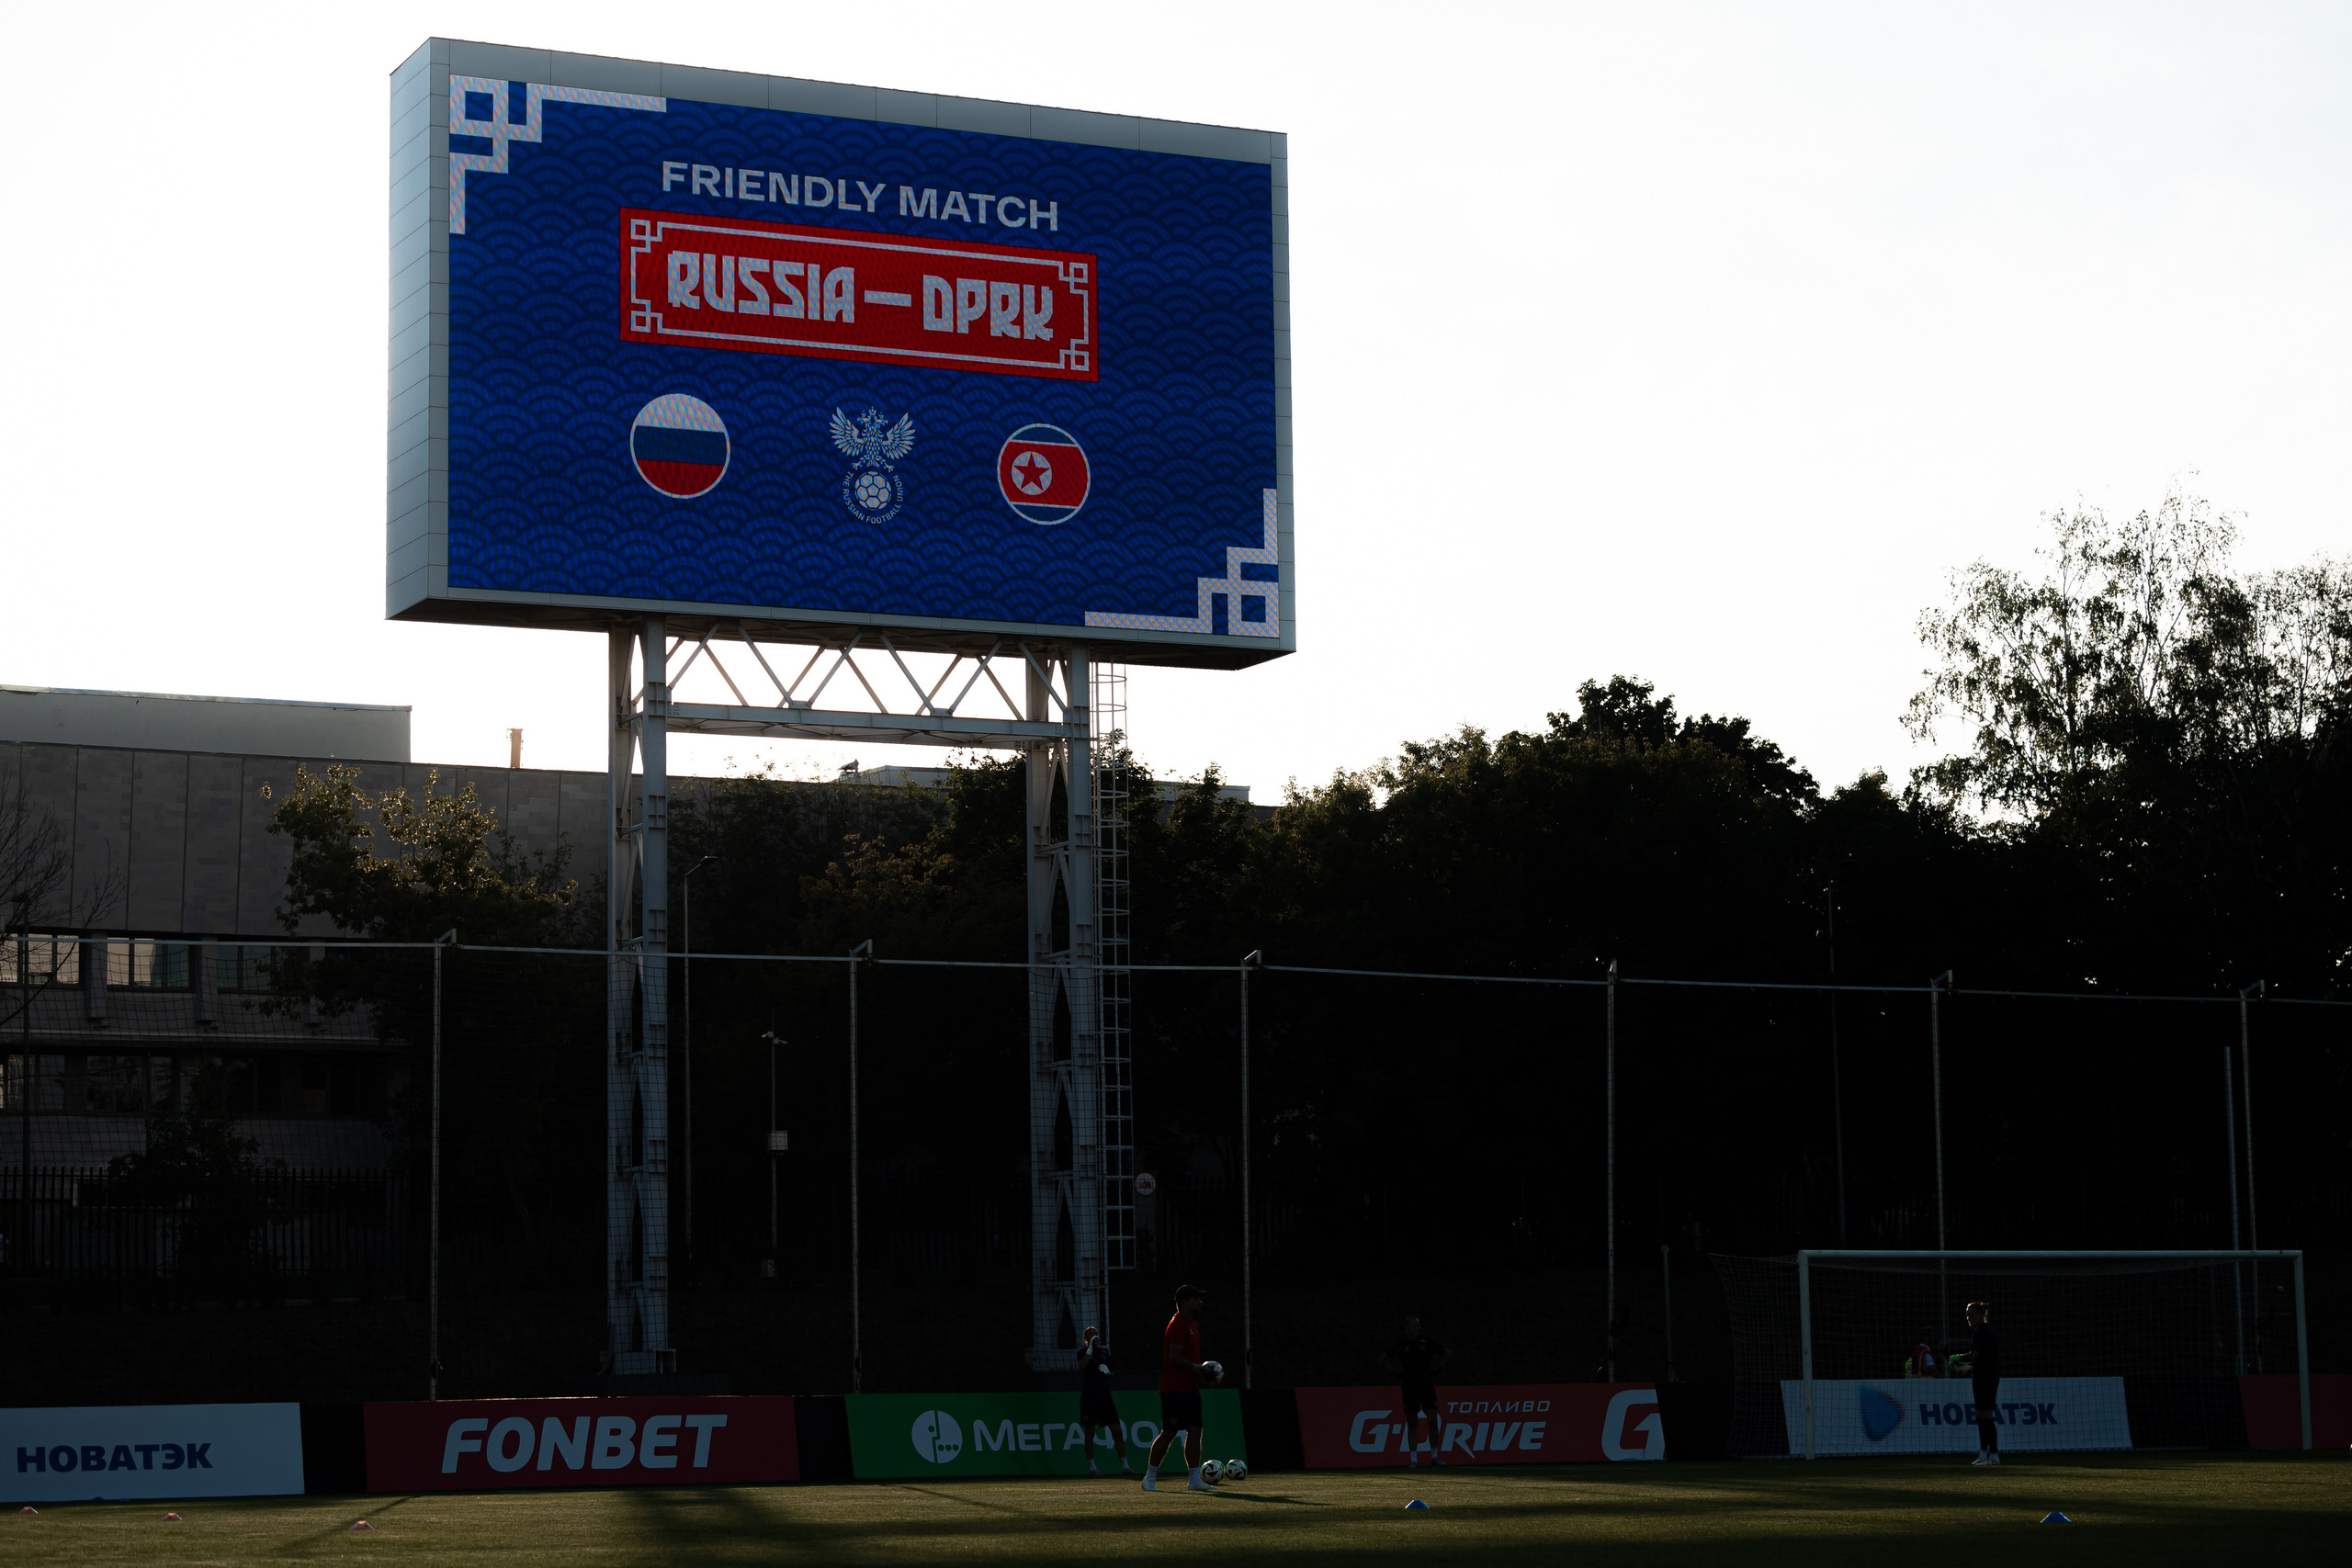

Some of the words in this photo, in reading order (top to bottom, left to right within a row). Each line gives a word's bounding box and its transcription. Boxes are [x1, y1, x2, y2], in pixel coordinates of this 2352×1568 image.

[662, 160, 887, 213] FRIENDLY
[899, 186, 1058, 231] MATCH
[667, 250, 855, 323] RUSSIA
[922, 274, 1054, 342] DPRK
[842, 471, 854, 487] THE
[892, 475, 903, 502] UNION
[842, 489, 865, 521] RUSSIAN
[865, 504, 901, 524] FOOTBALL
[1446, 1400, 1551, 1414] ТОПЛИВО
[441, 1414, 729, 1474] FONBET
[972, 1418, 1192, 1452] МЕГАФО
[17, 1443, 213, 1472] НОВАТЭК
